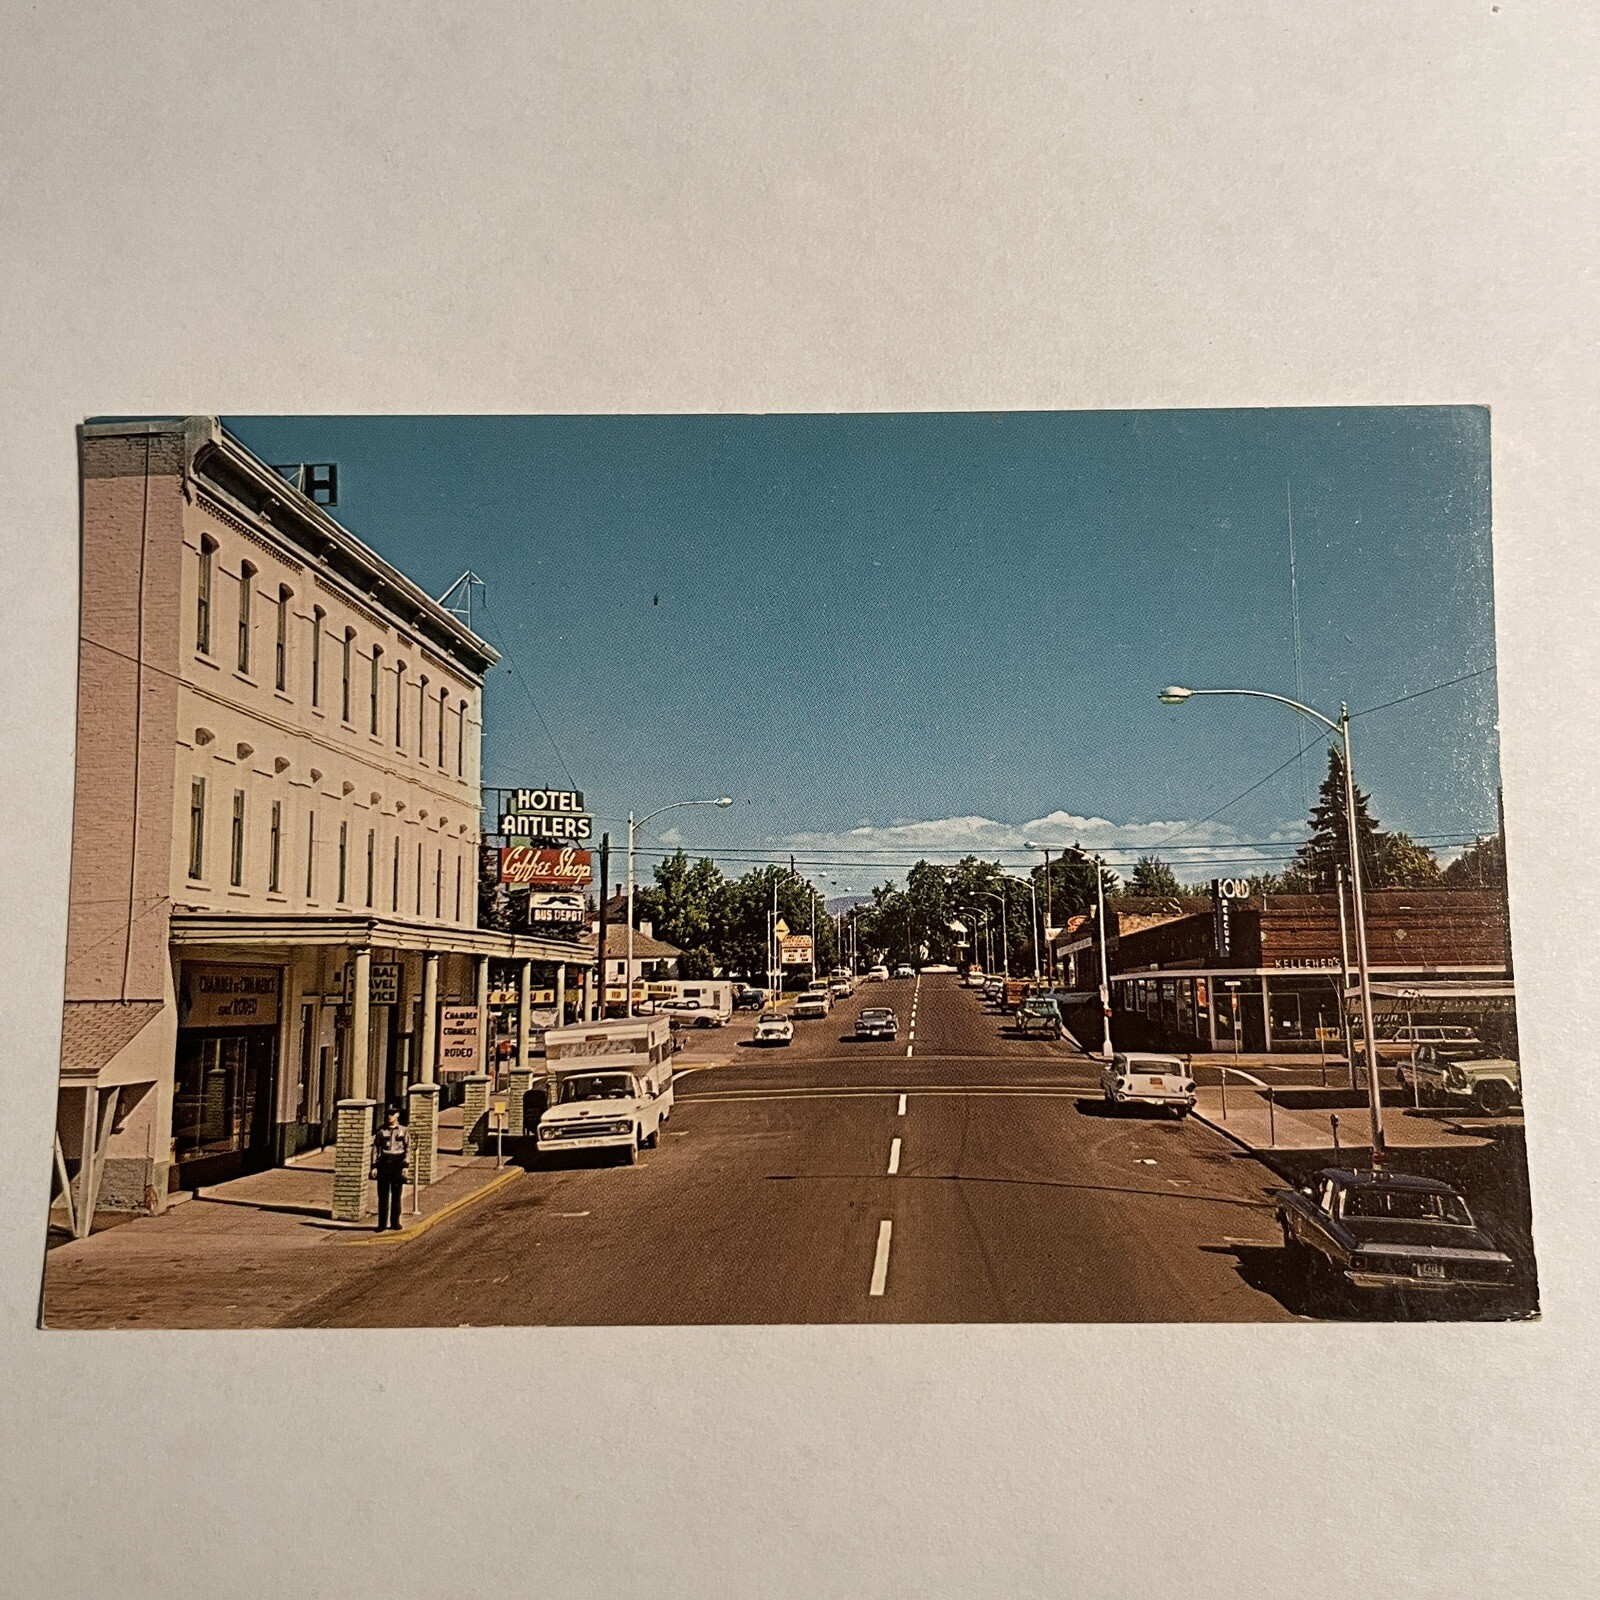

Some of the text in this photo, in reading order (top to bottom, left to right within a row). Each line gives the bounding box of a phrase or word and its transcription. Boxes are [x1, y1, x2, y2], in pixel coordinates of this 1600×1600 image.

[517, 790, 583, 812] HOTEL
[501, 814, 591, 838] ANTLERS
[502, 846, 592, 883] Coffee Shop
[534, 908, 583, 922] BUS DEPOT
[443, 1027, 477, 1035] COMMERCE
[444, 1047, 473, 1058] RODEO
